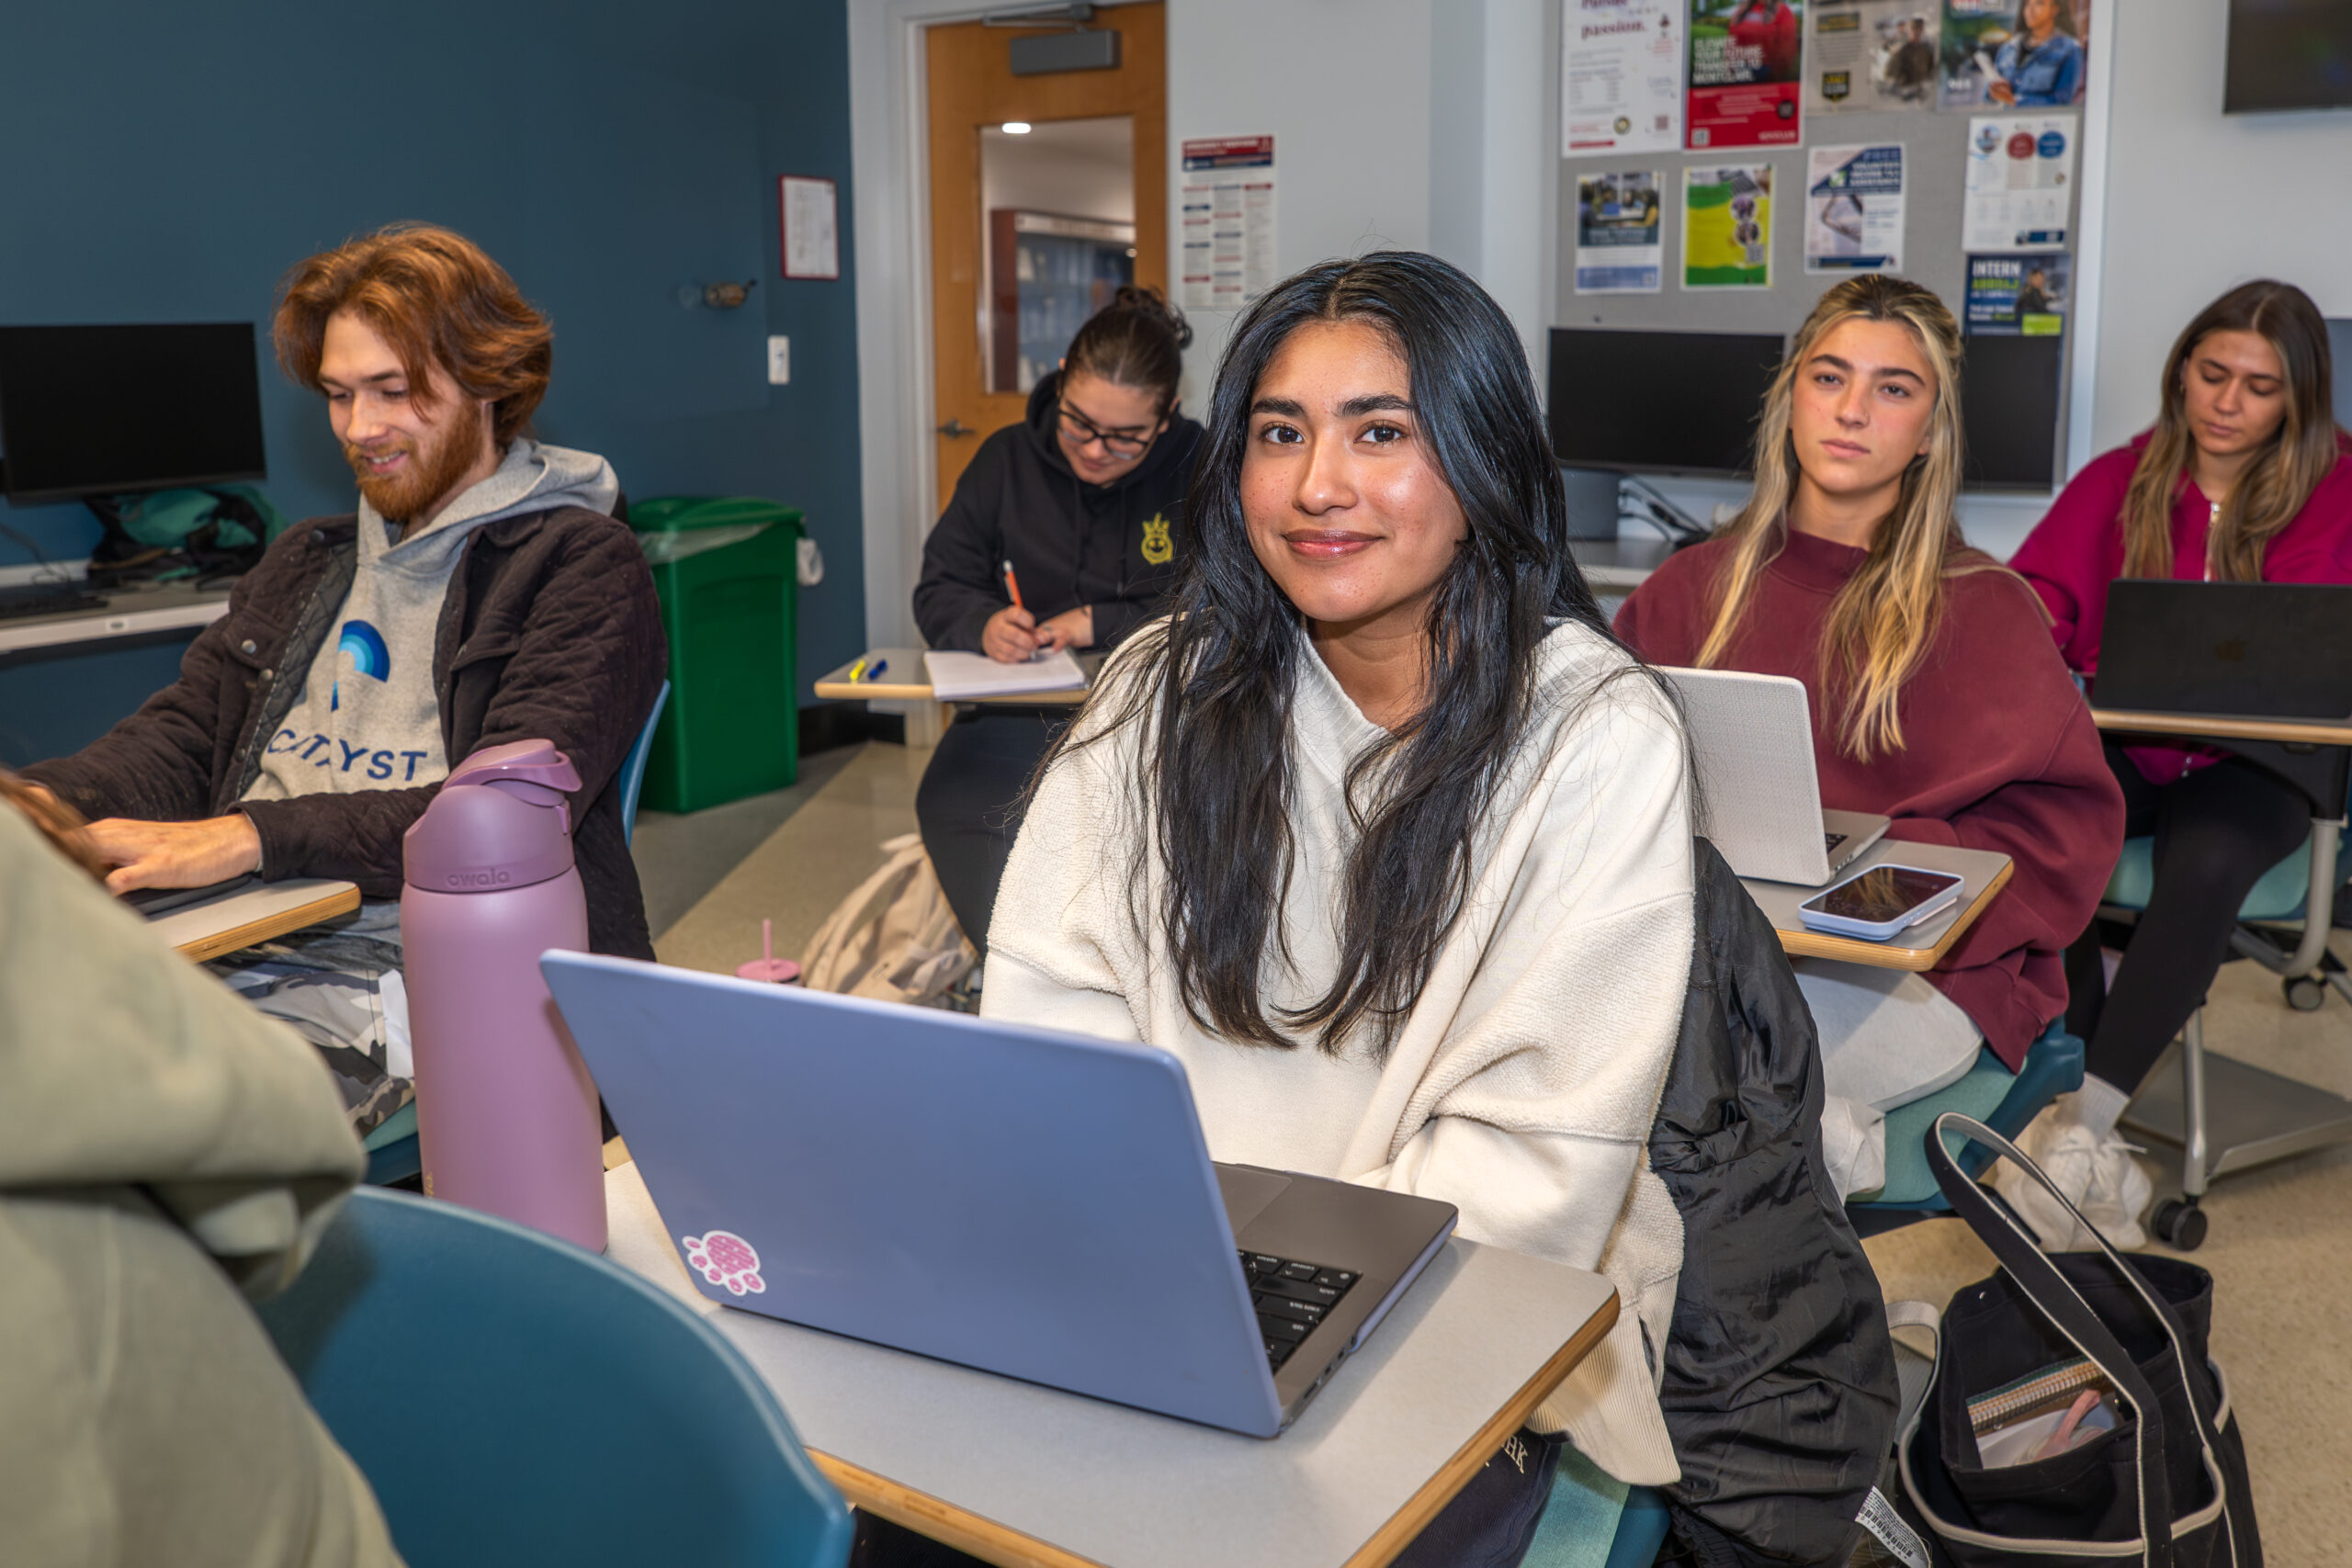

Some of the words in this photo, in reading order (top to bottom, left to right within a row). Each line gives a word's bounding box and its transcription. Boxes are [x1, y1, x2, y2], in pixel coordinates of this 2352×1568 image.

[1580, 21, 1645, 40] passion.
[1972, 260, 2021, 277] INTERN
[447, 866, 511, 886] owala
